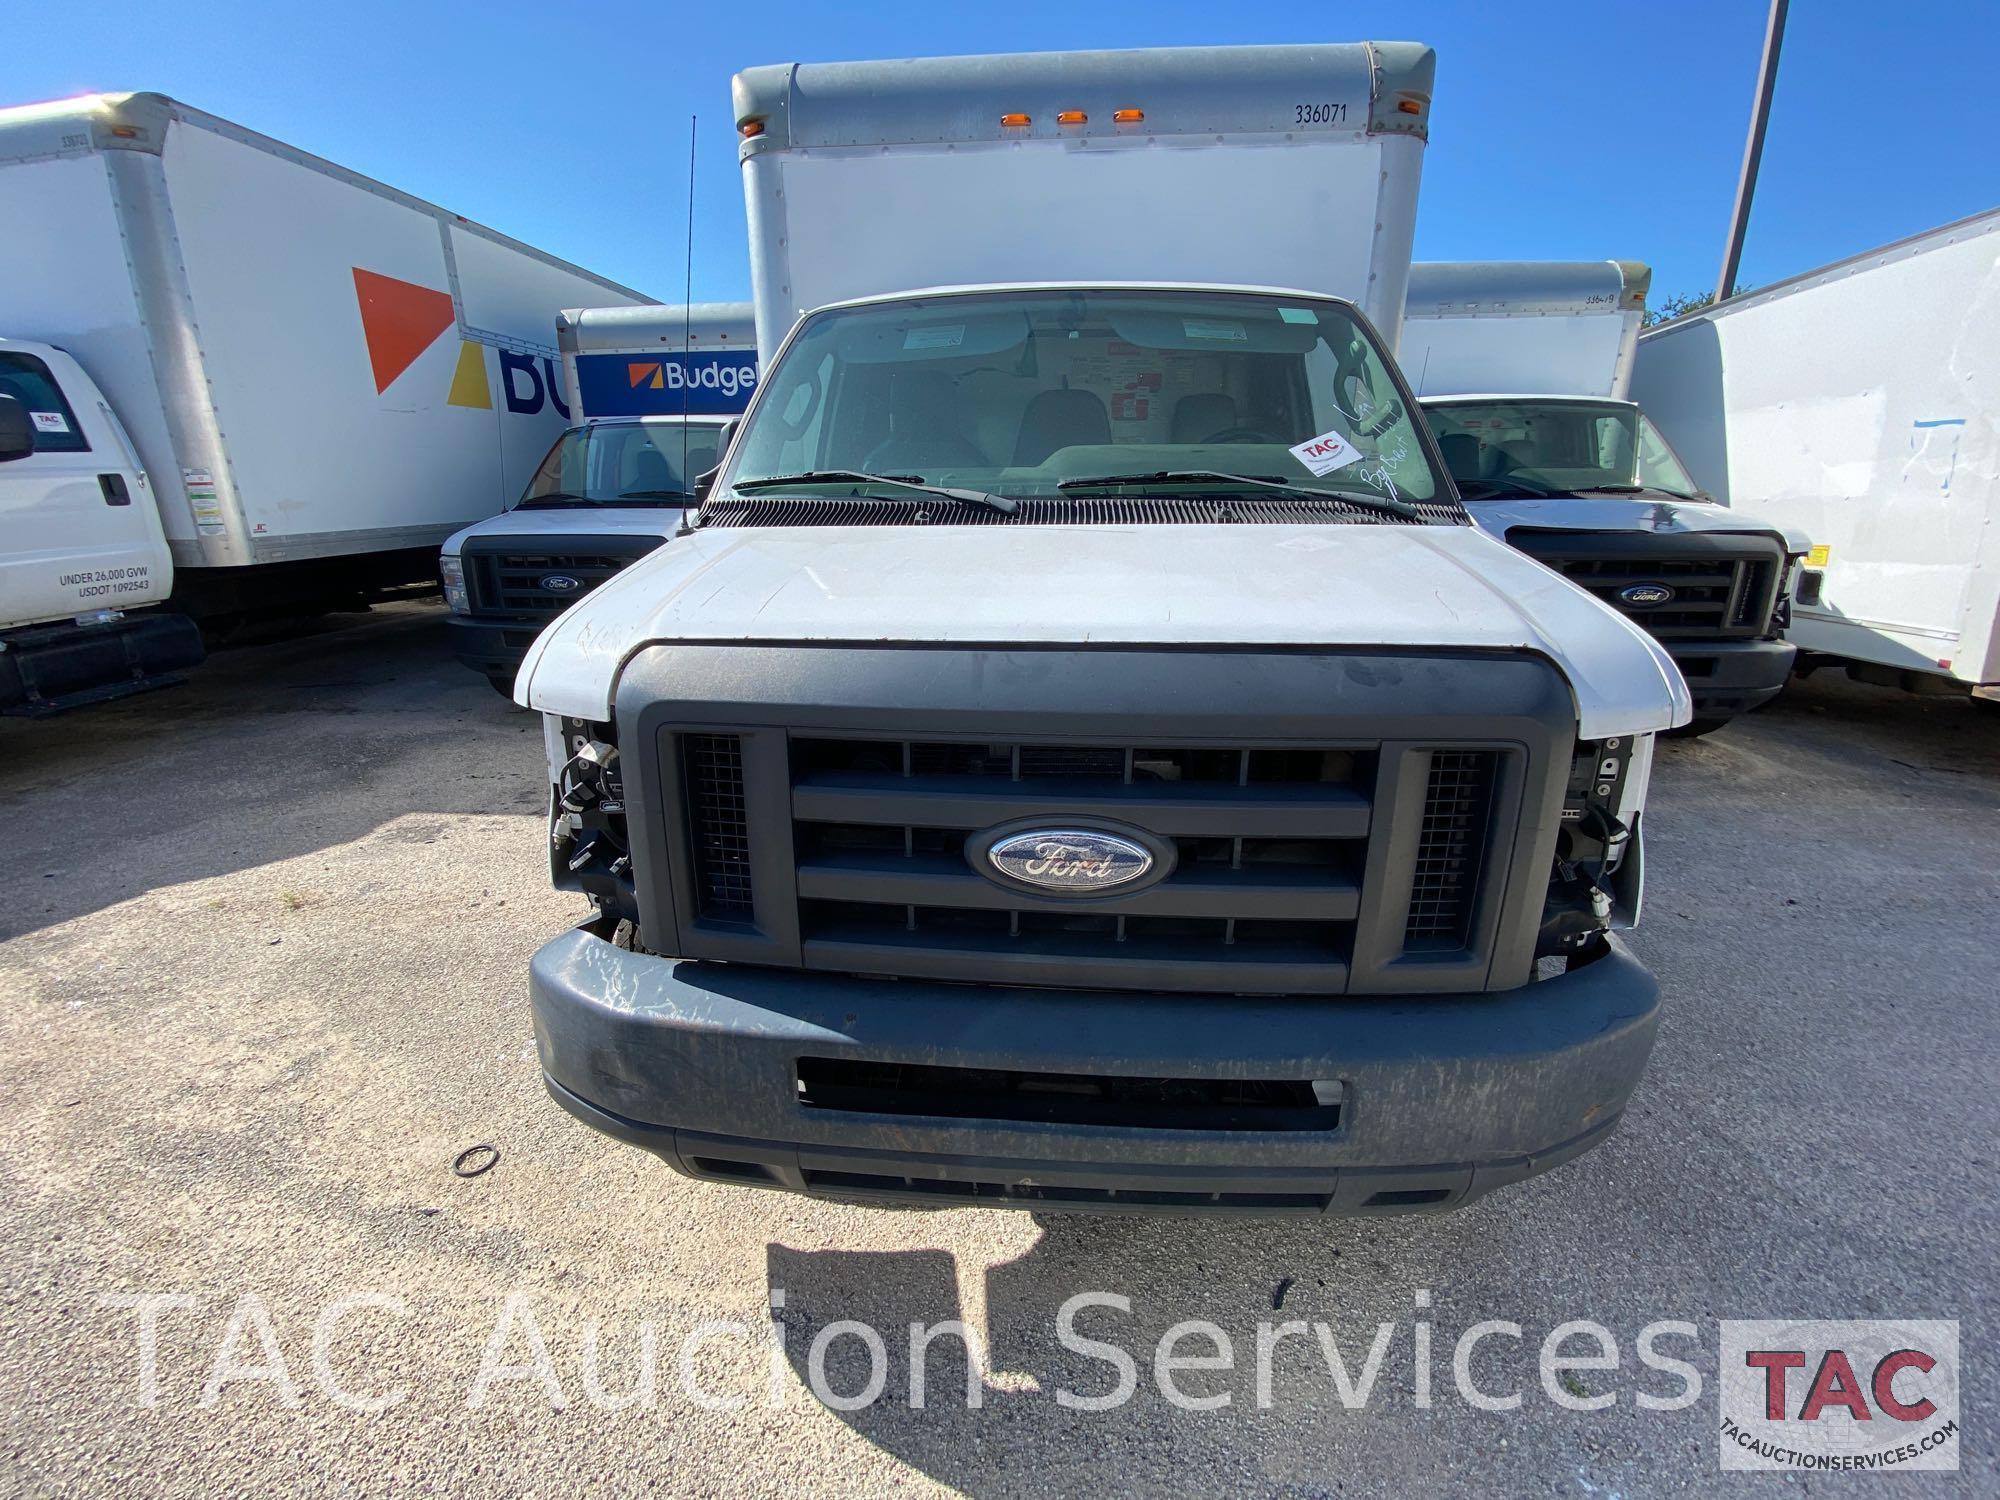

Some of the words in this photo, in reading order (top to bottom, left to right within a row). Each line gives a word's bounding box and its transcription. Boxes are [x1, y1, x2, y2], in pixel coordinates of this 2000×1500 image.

[1296, 104, 1346, 123] 336071
[37, 415, 59, 423] TAC
[1302, 438, 1339, 458] TAC
[60, 573, 93, 586] UNDER
[95, 569, 124, 582] 26,000
[127, 567, 148, 578] GVW
[79, 585, 110, 597] USDOT
[113, 580, 149, 593] 1092543
[1025, 842, 1115, 878] Ford
